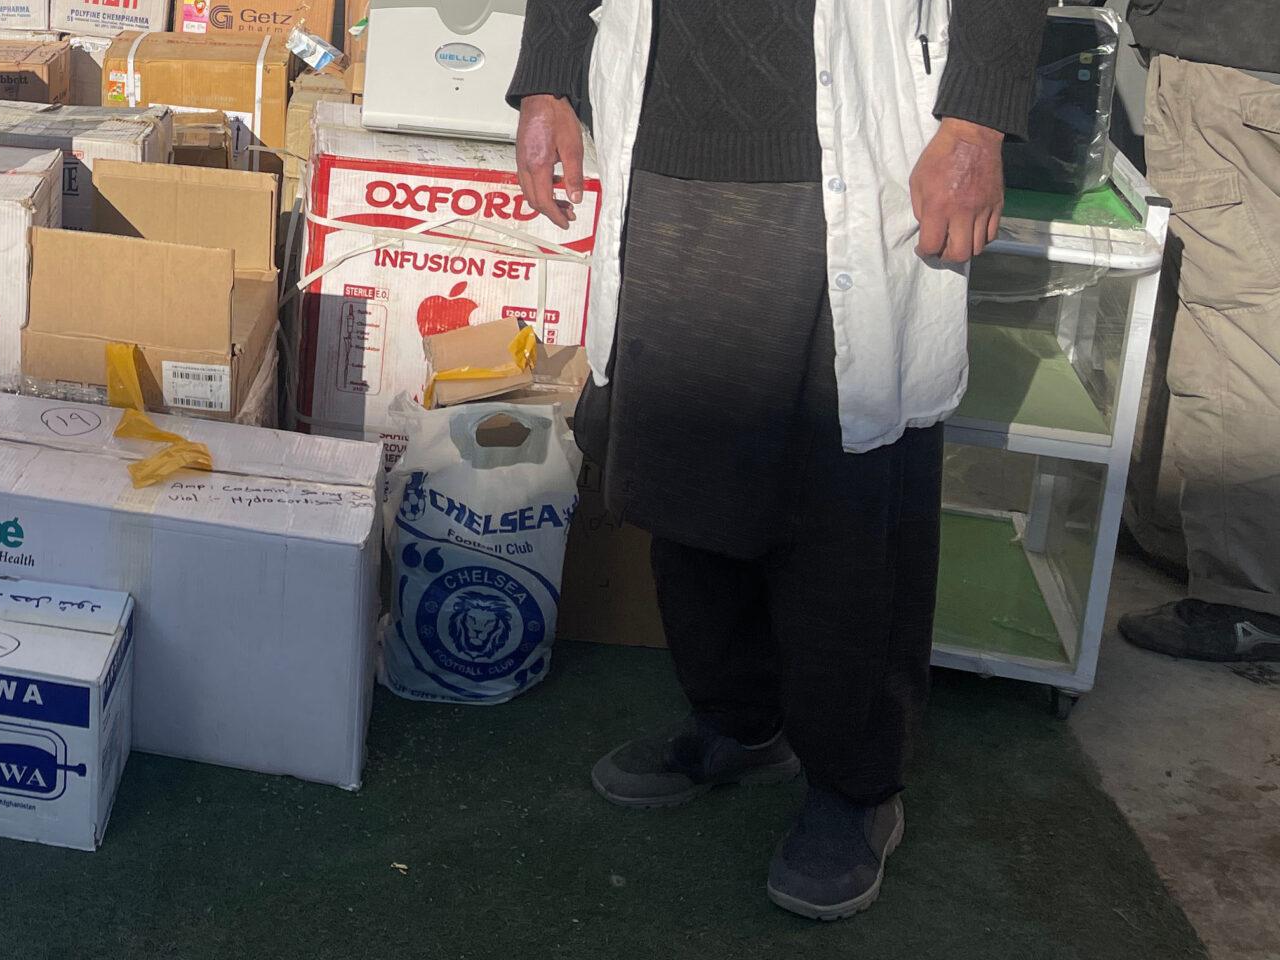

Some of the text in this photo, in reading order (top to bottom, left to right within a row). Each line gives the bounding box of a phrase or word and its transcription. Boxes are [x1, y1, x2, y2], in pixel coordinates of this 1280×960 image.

[71, 9, 101, 20] POLYFINE
[102, 12, 149, 25] CHEMPHARMA
[240, 9, 293, 25] Getz
[238, 25, 285, 33] pharm
[374, 248, 536, 280] INFUSION SET
[345, 287, 374, 298] STERILE
[429, 489, 563, 536] CHELSEA
[506, 542, 534, 556] Club
[444, 570, 528, 605] CHELSEA
[434, 648, 515, 675] FOOTBALL CLUB
